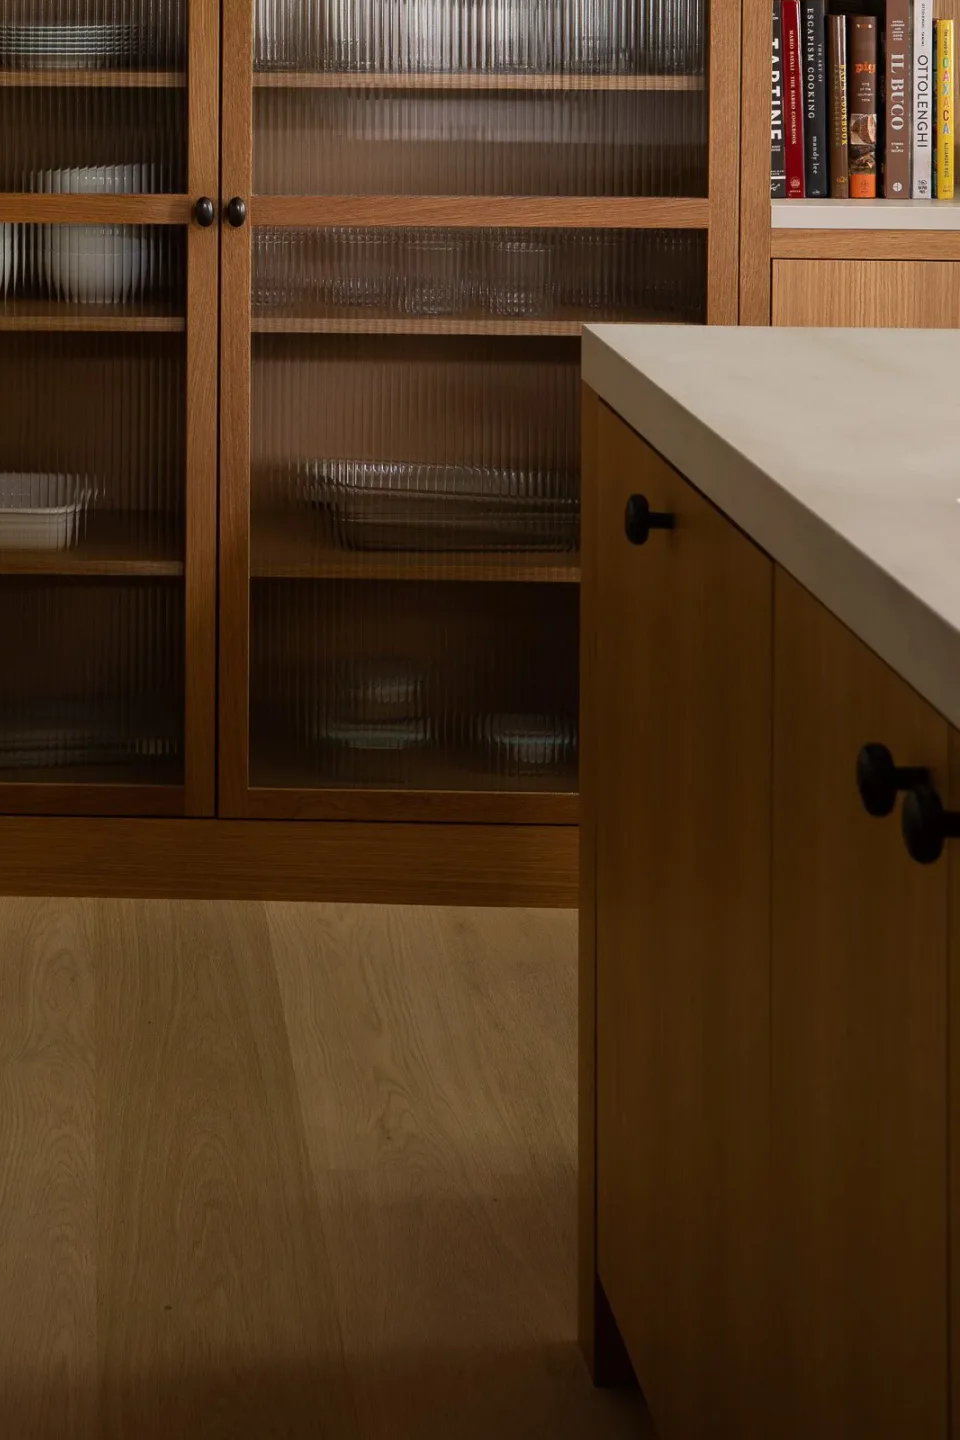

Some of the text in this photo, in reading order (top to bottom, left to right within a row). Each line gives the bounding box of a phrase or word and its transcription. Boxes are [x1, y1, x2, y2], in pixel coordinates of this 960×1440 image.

[854, 62, 876, 73] pig
[891, 54, 904, 73] IL
[807, 67, 815, 119] COOKING
[891, 78, 904, 130] BUCO
[918, 55, 928, 148] OTTOLENGHI
[942, 57, 950, 135] OAXACA
